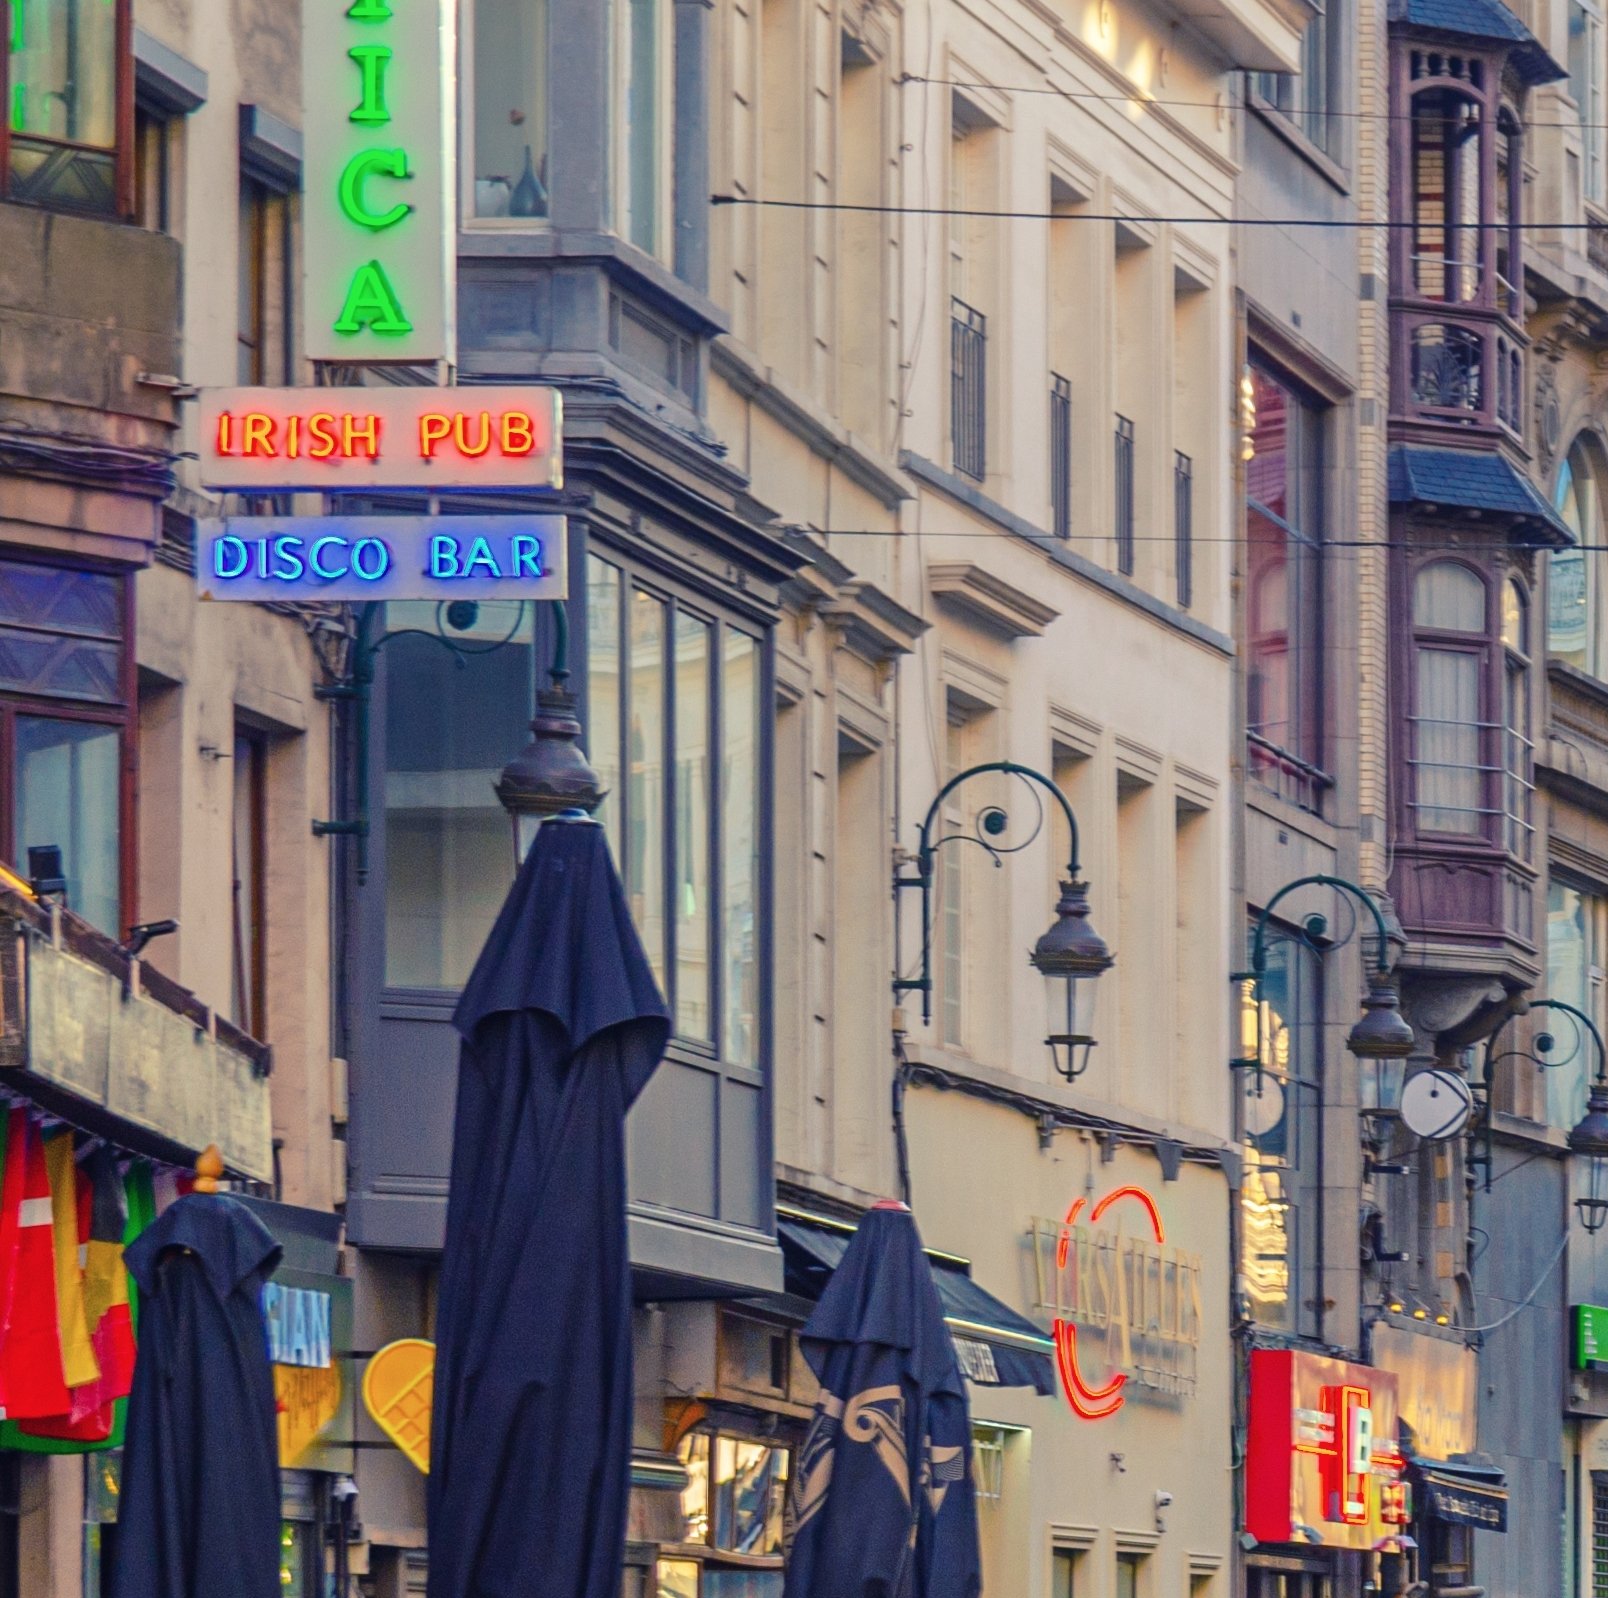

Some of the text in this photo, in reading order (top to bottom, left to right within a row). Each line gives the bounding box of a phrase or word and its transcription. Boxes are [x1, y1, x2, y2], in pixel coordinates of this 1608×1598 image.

[216, 411, 537, 460] IRISH PUB
[213, 533, 544, 580] DISCO BAR
